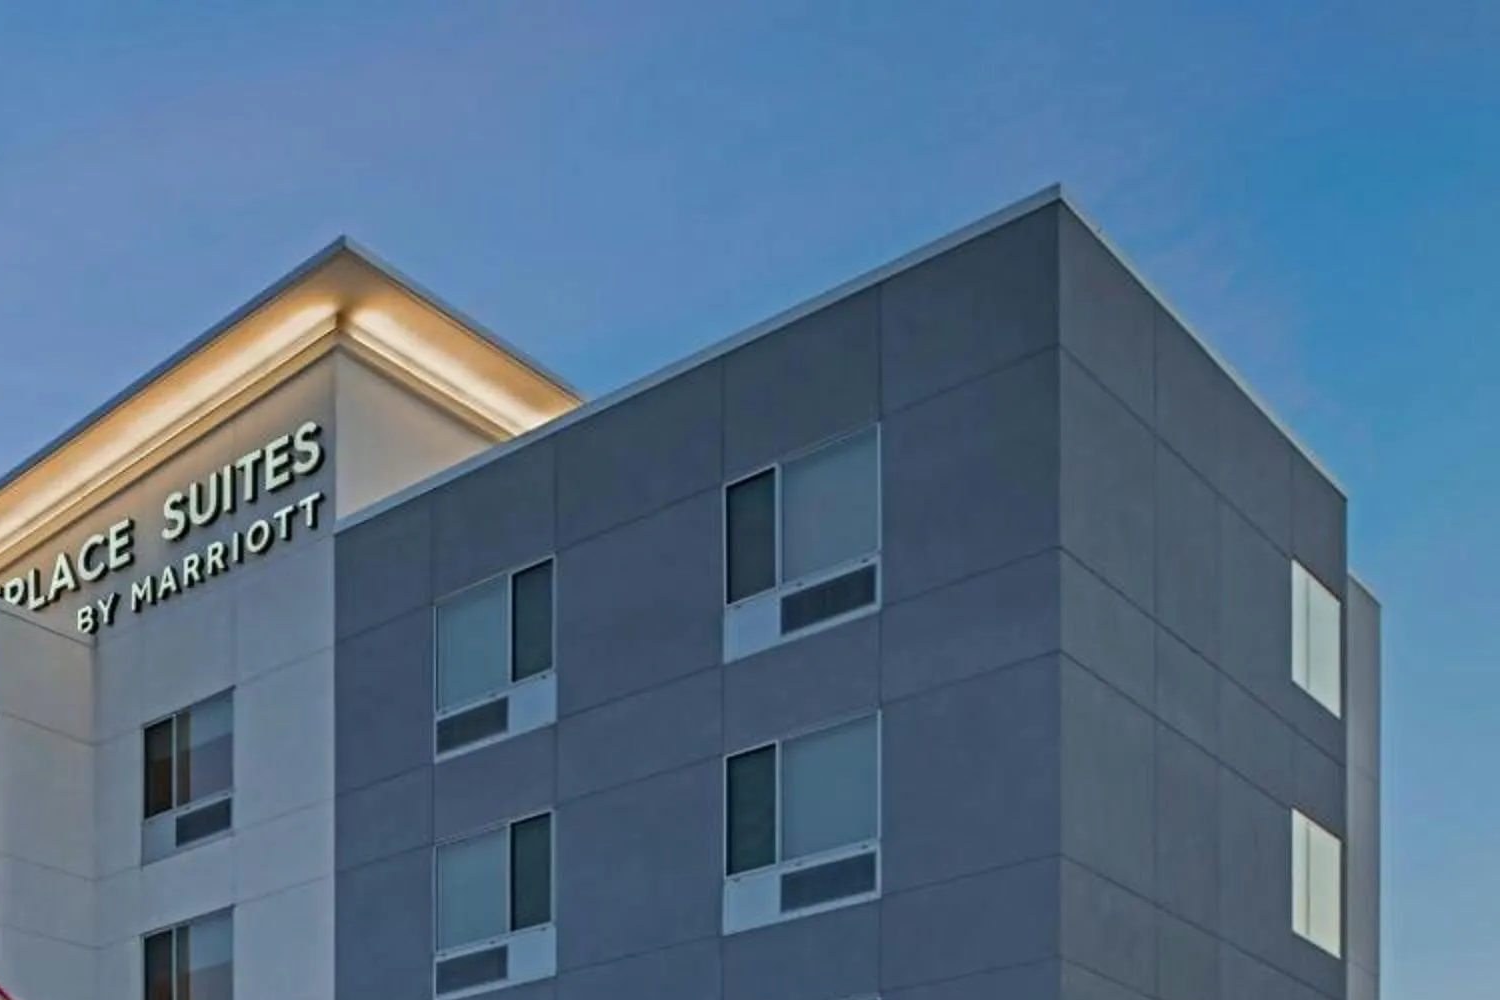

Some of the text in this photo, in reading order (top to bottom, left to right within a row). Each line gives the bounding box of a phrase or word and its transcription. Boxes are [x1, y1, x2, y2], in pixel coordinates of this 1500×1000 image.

[161, 421, 323, 541] SUITES
[77, 491, 324, 634] BY MARRIOTT
